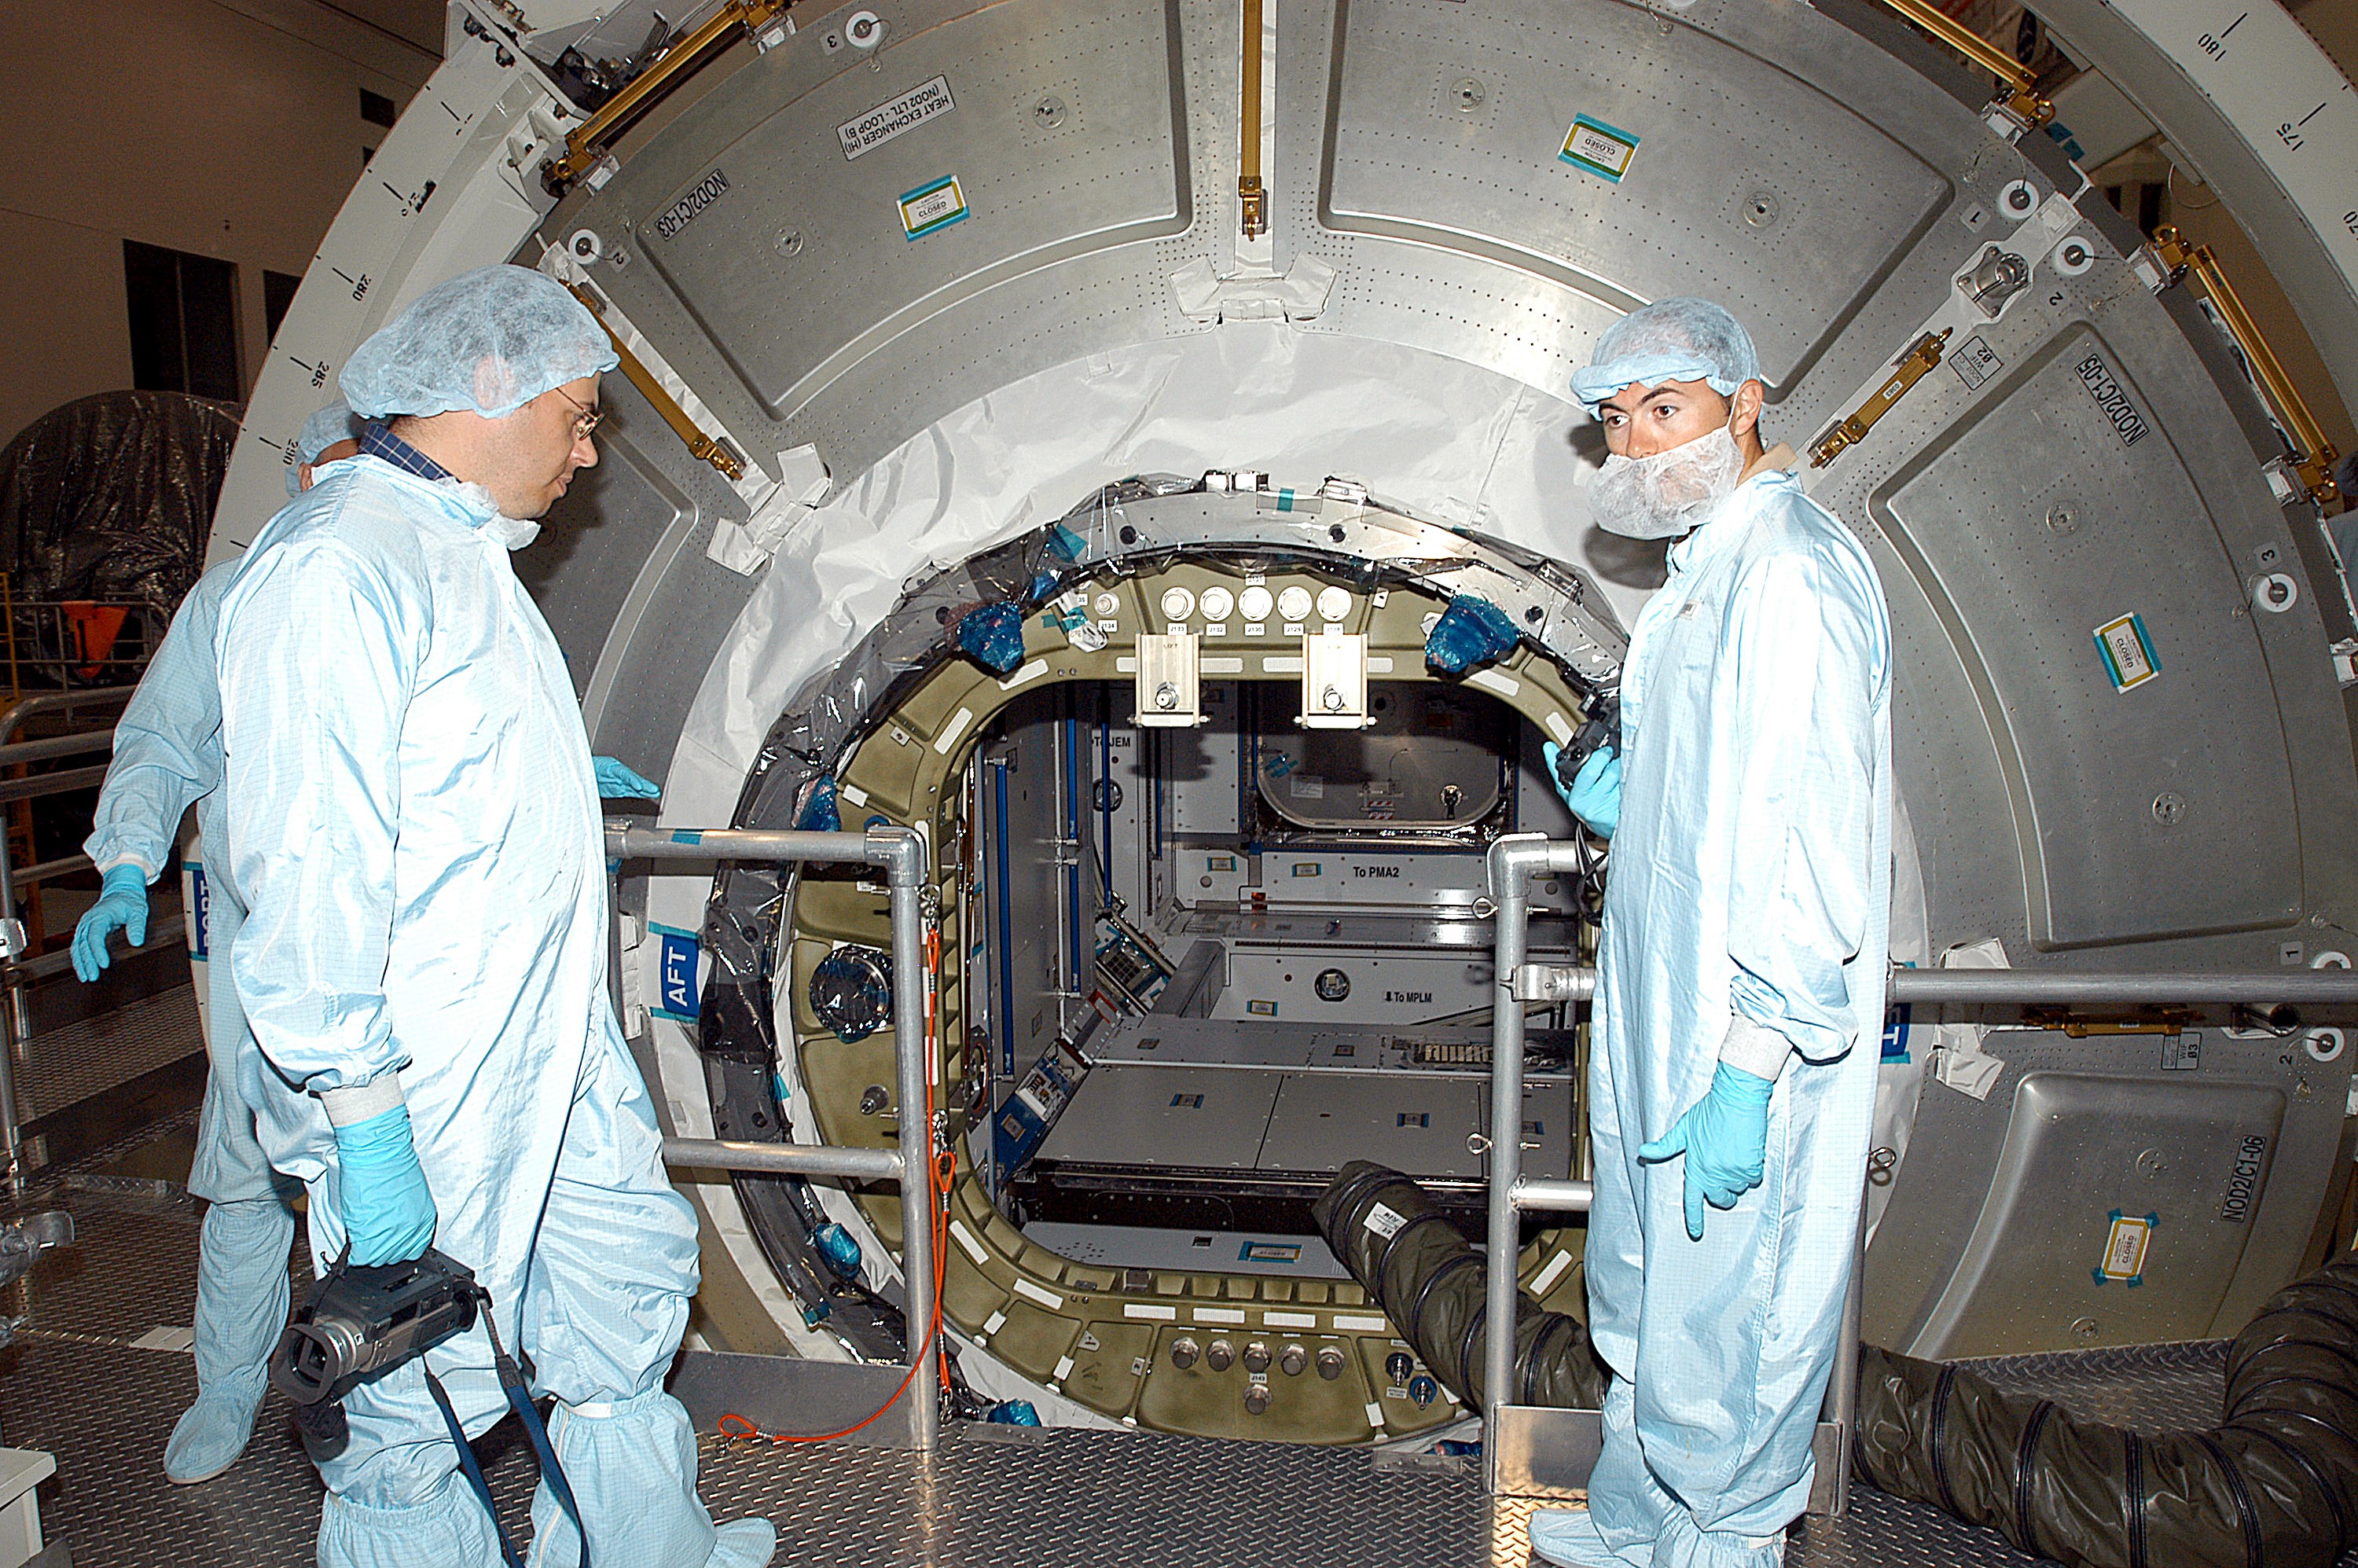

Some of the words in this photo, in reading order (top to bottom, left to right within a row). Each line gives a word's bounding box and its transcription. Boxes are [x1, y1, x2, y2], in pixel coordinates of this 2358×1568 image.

[827, 35, 837, 48] 3
[2198, 33, 2227, 62] 180
[909, 83, 939, 108] (NOD2
[924, 94, 949, 116] HEAT
[890, 101, 909, 116] LTL
[845, 127, 857, 139] B)
[858, 114, 885, 134] LOOP
[864, 108, 922, 145] EXCHANGER
[1585, 138, 1615, 156] CLOSED
[2275, 123, 2304, 151] 175
[658, 172, 727, 237] NOD2/C1-03
[918, 201, 946, 217] CLOSED
[1970, 211, 1981, 224] 1
[613, 252, 624, 264] 2
[352, 274, 372, 302] 280
[2049, 292, 2063, 306] 2
[1971, 355, 1985, 371] WIF
[311, 361, 330, 388] 285
[2077, 358, 2146, 443] NOD2/C1-05
[282, 439, 299, 465] 290
[2261, 549, 2275, 561] 3
[2117, 637, 2133, 668] CLOSED
[1109, 736, 1130, 747] JEM
[1353, 866, 1366, 878] To
[1368, 866, 1399, 878] PMA2
[667, 946, 688, 1007] AFT
[1394, 992, 1405, 1002] To
[1406, 993, 1432, 1003] MPLM
[2279, 1054, 2293, 1066] 2
[2223, 1137, 2264, 1221] NOD2/C1-06
[2122, 1235, 2134, 1263] CLOSED
